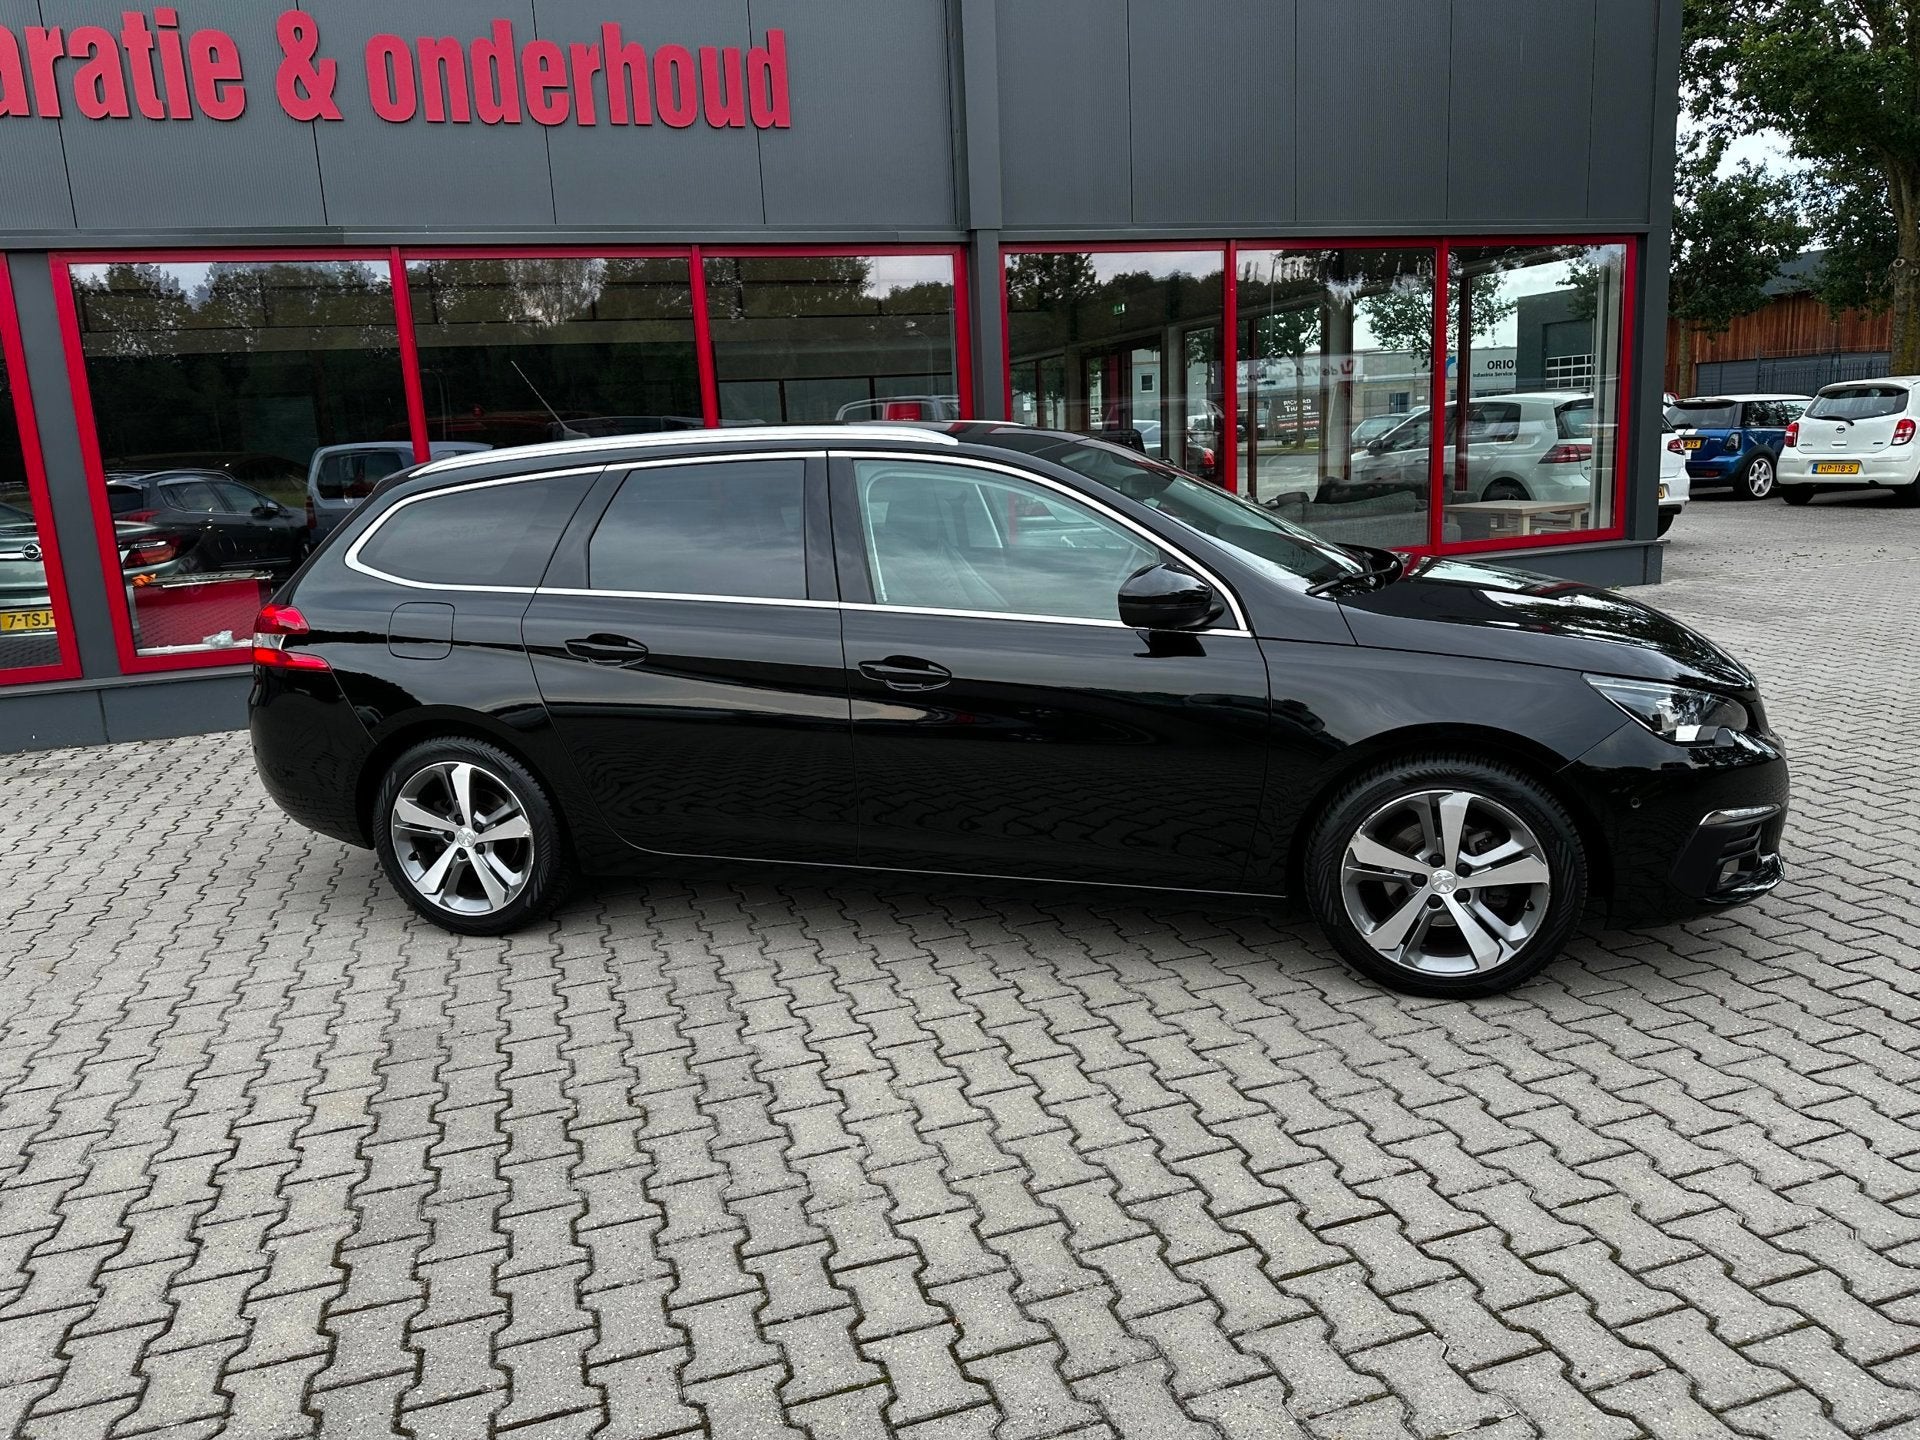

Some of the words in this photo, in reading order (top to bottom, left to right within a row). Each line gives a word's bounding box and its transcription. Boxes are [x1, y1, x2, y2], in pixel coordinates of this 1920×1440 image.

[275, 9, 343, 121] &
[365, 19, 791, 129] onderhoud
[1820, 464, 1854, 472] HP-118-S
